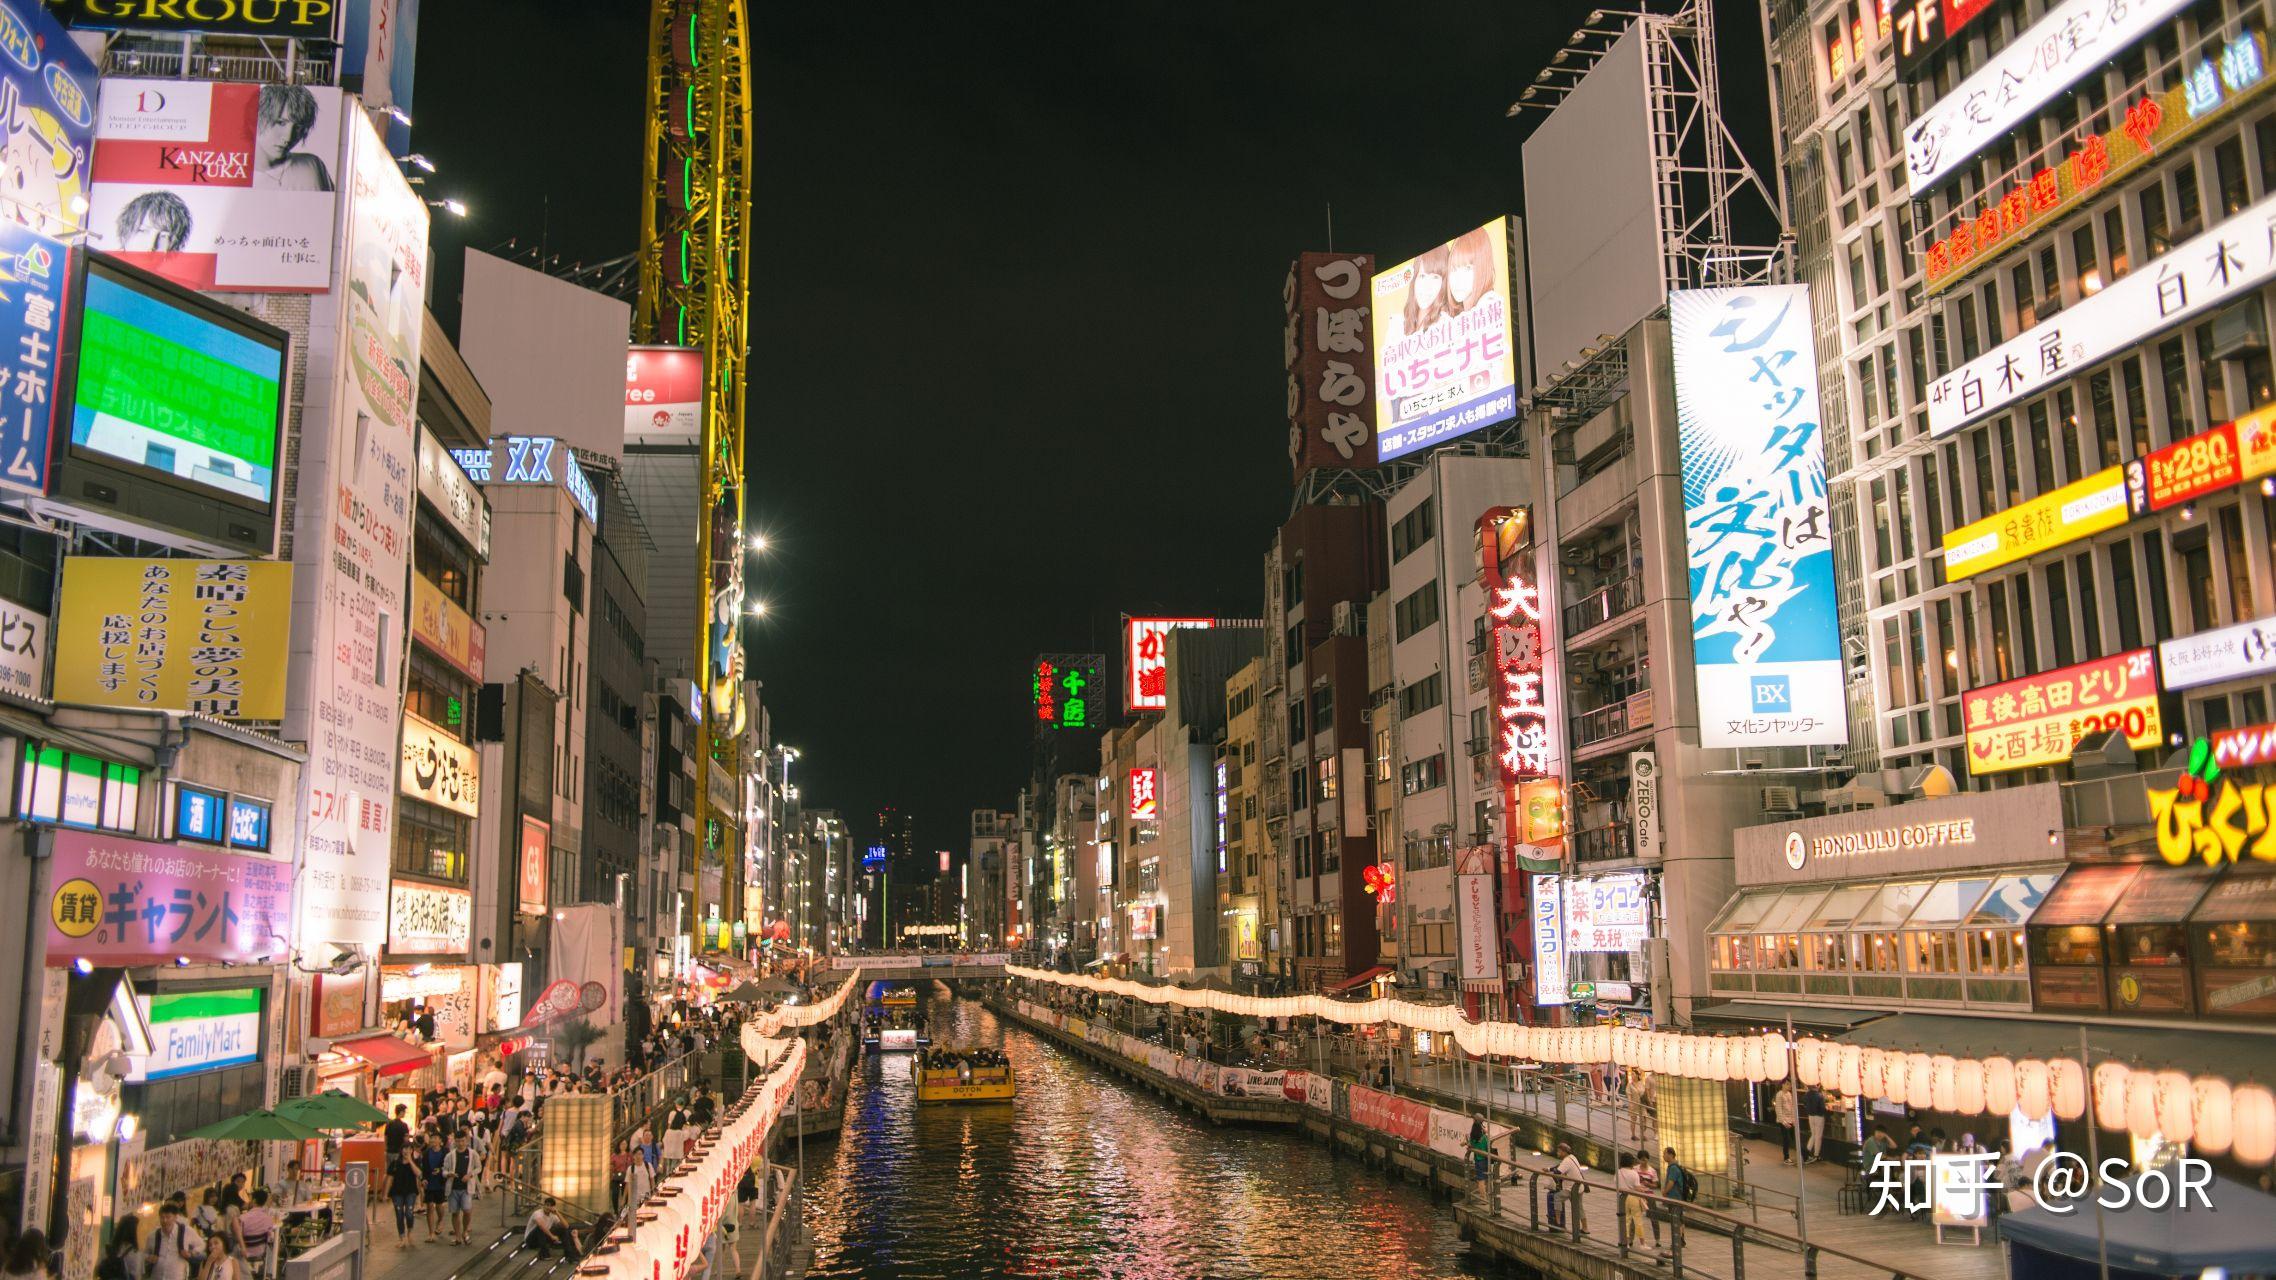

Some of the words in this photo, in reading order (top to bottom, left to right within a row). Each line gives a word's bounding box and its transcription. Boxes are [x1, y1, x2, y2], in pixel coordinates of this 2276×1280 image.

[1896, 0, 1938, 57] 7F
[158, 146, 250, 170] KANZAKI
[191, 163, 248, 183] RUKA
[213, 235, 311, 249] めっちゃ面白いを
[1313, 255, 1372, 460] づぼらや
[1958, 328, 2069, 417] 白木屋
[7, 292, 55, 483] 富士ホーム
[1932, 378, 1952, 405] 4F
[136, 564, 171, 704] あなたのお店づくり
[187, 563, 250, 719] 素晴らしい夢の実現
[98, 615, 133, 693] 応援します
[2127, 653, 2151, 680] 2F
[1488, 574, 1549, 776] 大阪王将
[1756, 683, 1785, 706] BX
[1967, 664, 2128, 729] 豊後高田どり
[1726, 718, 1825, 736] 文化シャッター
[1996, 720, 2065, 762] 酒場
[63, 793, 98, 812] amilyMart
[1636, 780, 1651, 819] ZERO
[230, 804, 259, 843] たばこ
[1813, 826, 1898, 857] HONOLULU
[1901, 818, 1976, 848] COFFEE
[58, 891, 99, 926] 賃貸
[103, 879, 239, 946] ギャラント
[1592, 928, 1622, 948] 免税
[167, 1021, 242, 1063] FamilyMart
